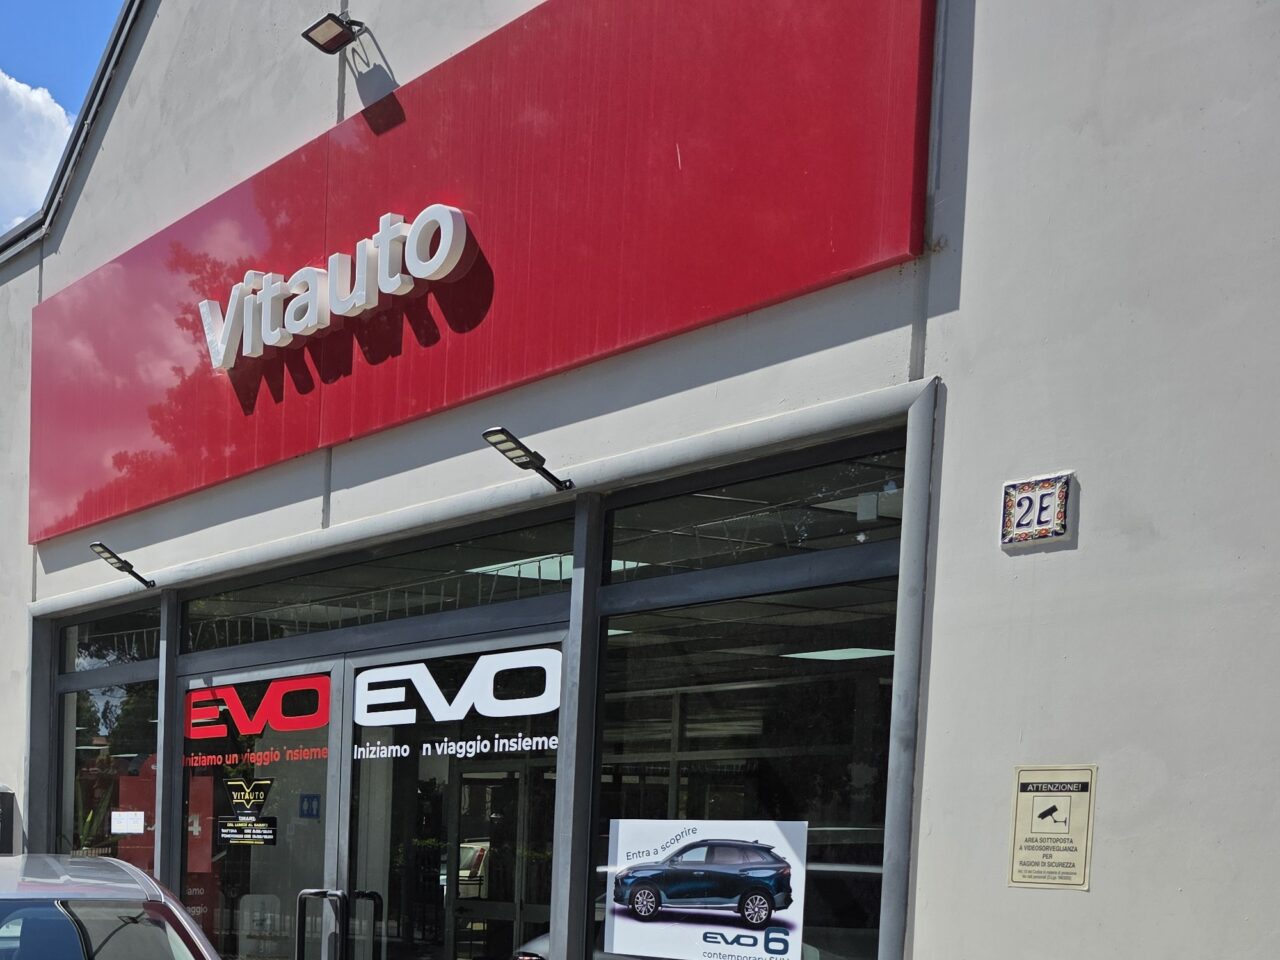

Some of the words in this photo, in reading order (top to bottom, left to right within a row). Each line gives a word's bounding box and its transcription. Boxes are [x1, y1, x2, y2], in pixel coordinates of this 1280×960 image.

[1016, 491, 1055, 528] 2E
[354, 648, 562, 726] EVO
[184, 674, 331, 739] EVO
[225, 753, 239, 765] un
[242, 747, 280, 766] viaggio
[283, 744, 329, 761] nsieme
[353, 735, 410, 759] Iniziamo
[435, 736, 490, 758] viaggio
[493, 732, 559, 753] insieme
[232, 791, 265, 799] VITAUTO
[626, 848, 651, 861] Entra
[653, 848, 659, 856] a
[661, 826, 698, 853] scoprire
[702, 931, 758, 947] EVO
[763, 927, 790, 955] 6
